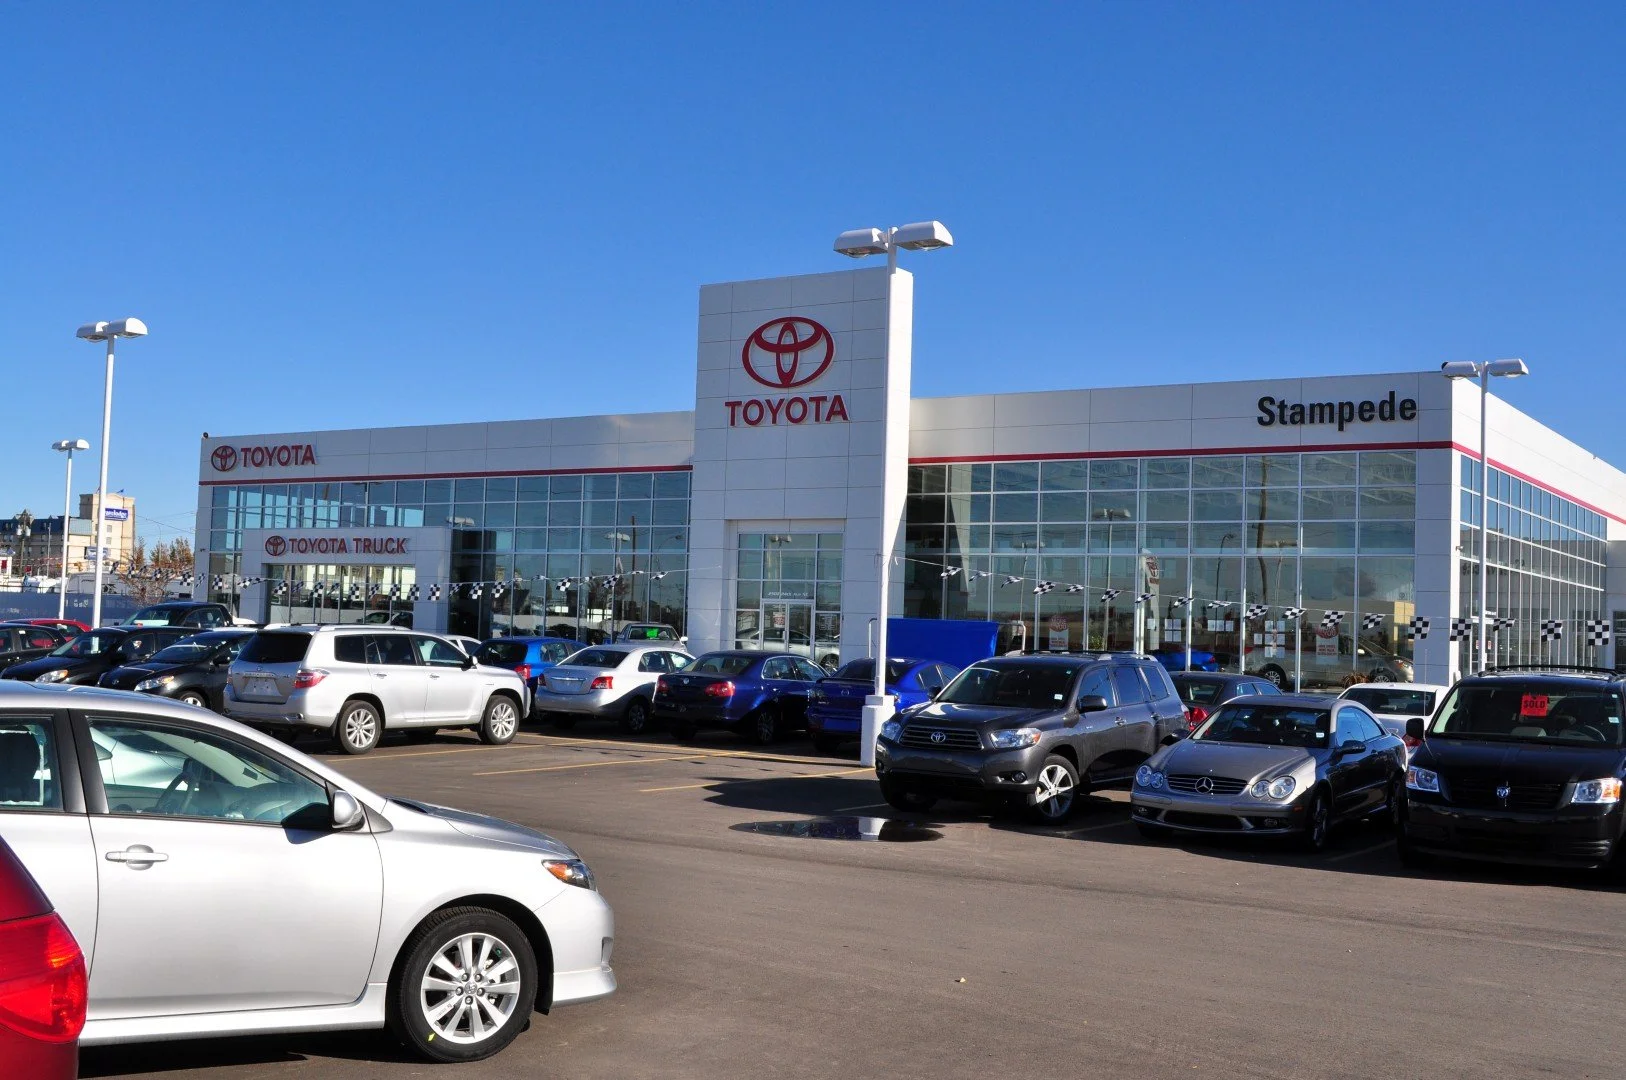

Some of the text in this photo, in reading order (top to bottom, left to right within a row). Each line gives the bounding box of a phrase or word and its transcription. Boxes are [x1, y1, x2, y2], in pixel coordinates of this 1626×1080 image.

[725, 394, 849, 426] TOYOTA
[1257, 391, 1418, 432] Stampede
[240, 444, 316, 468] TOYOTA
[288, 537, 407, 554] TOYOTA TRUCK
[1523, 699, 1546, 709] SOLD
